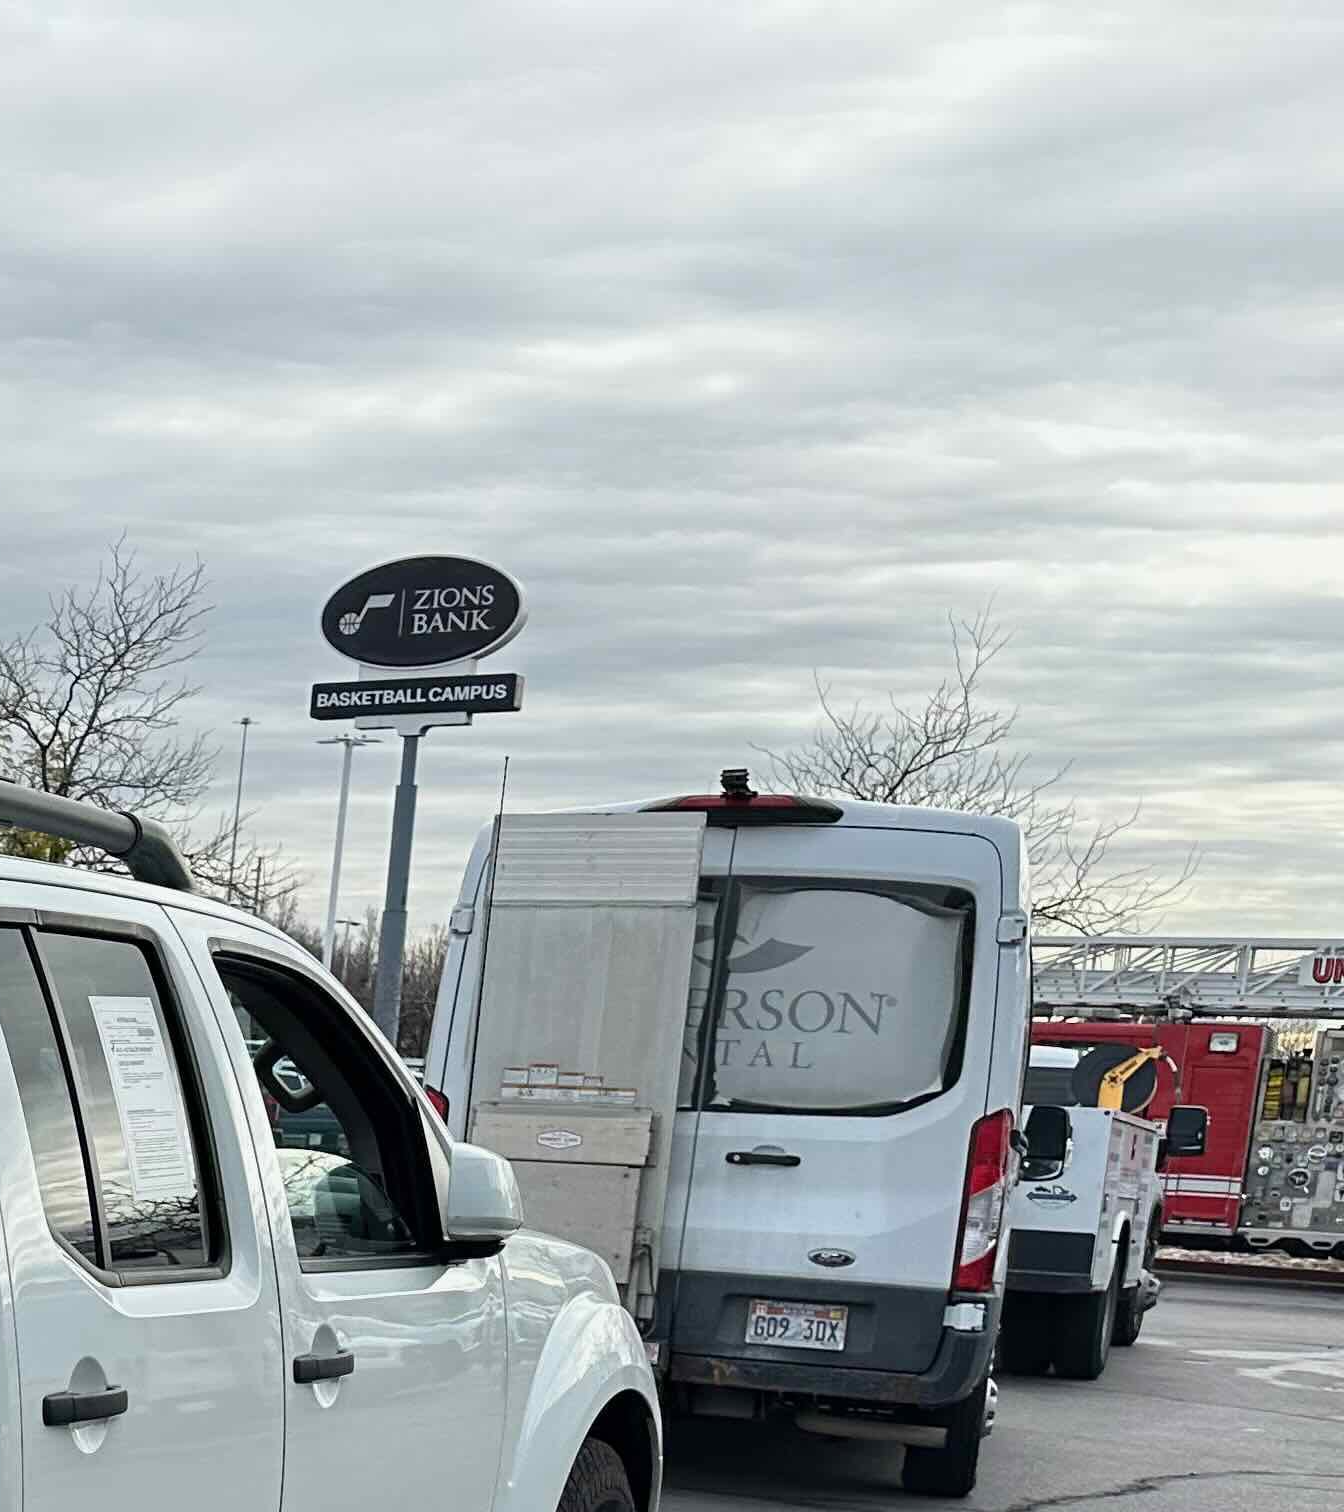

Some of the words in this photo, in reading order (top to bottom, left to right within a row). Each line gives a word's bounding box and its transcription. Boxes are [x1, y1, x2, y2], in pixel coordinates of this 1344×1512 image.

[413, 585, 495, 610] ZIONS
[411, 610, 495, 635] BANK
[316, 687, 426, 708] BASKETBALL
[428, 684, 507, 703] CAMPUS
